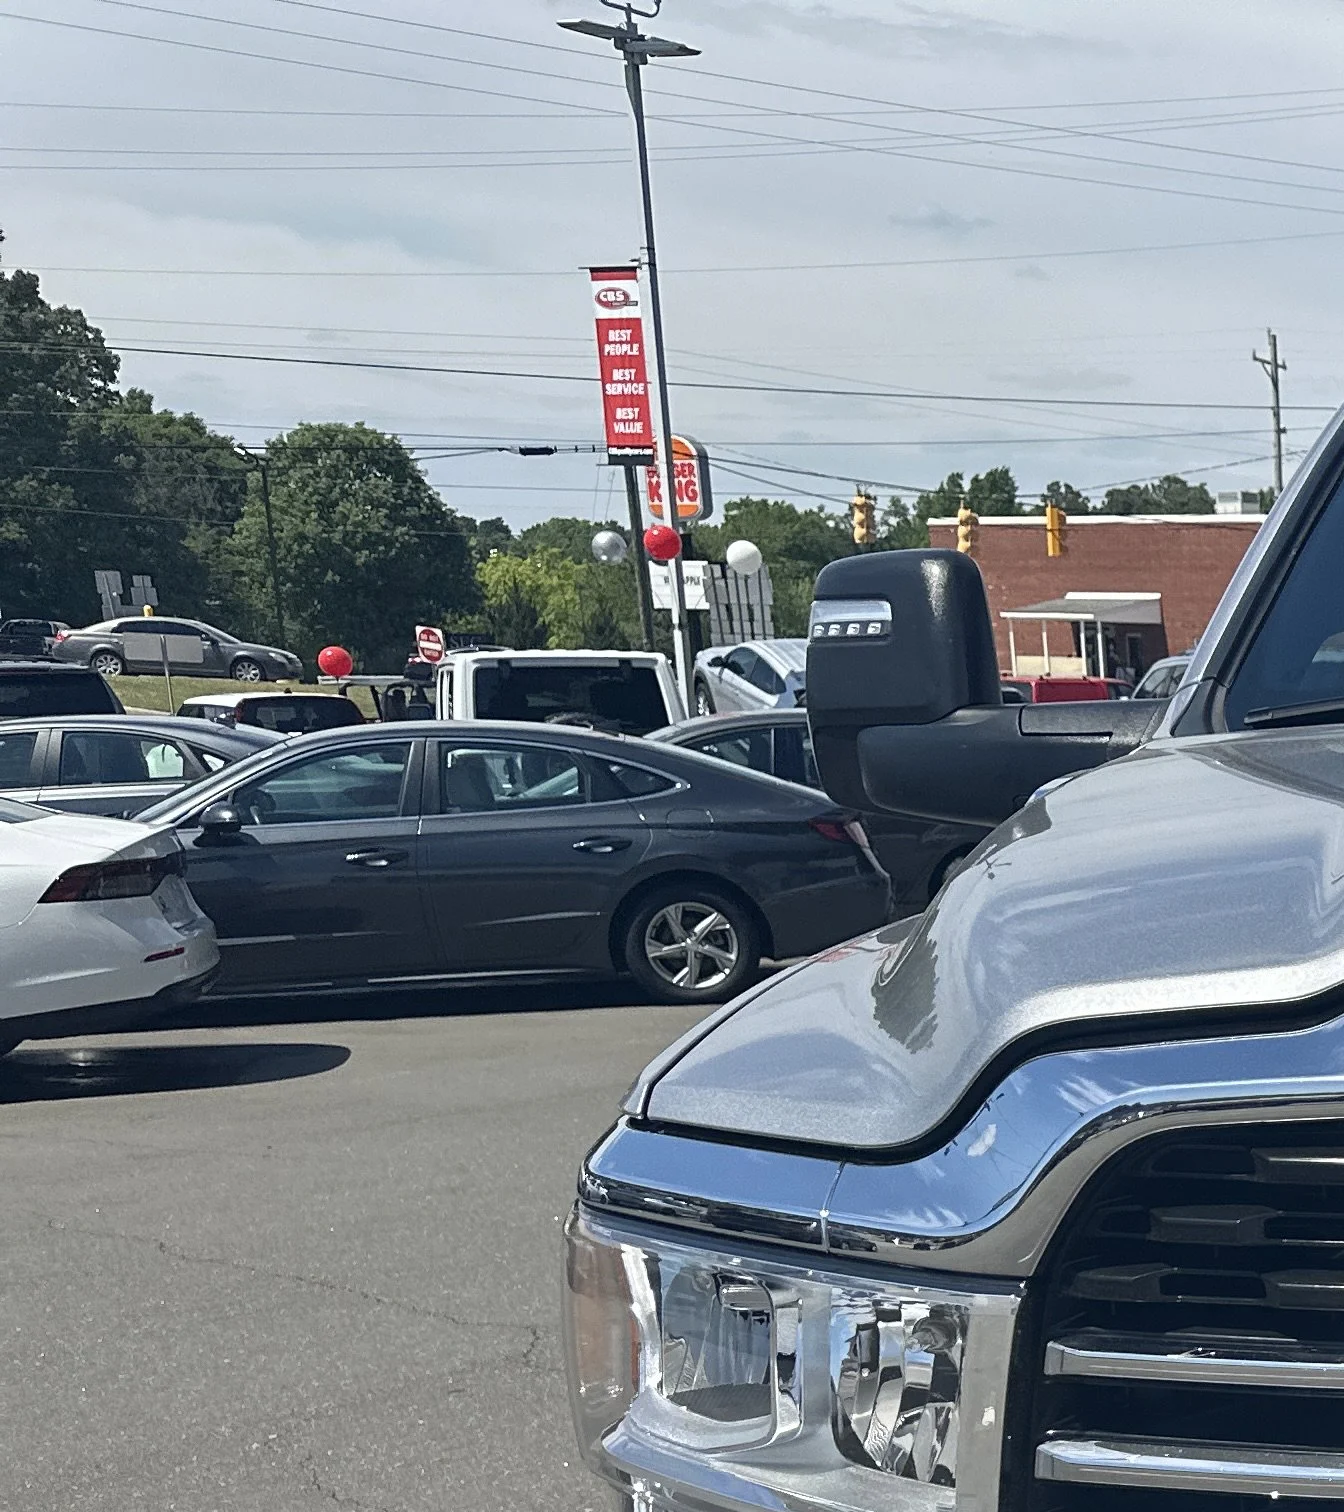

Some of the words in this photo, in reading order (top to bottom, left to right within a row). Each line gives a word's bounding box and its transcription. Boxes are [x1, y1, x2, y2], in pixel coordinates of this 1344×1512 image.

[599, 290, 625, 301] CBS
[608, 329, 632, 341] BEST
[604, 343, 639, 355] PEOPLE
[612, 368, 636, 380] BEST
[605, 382, 644, 395] SERVICE
[615, 407, 639, 419] BEST
[613, 421, 643, 433] VALUE
